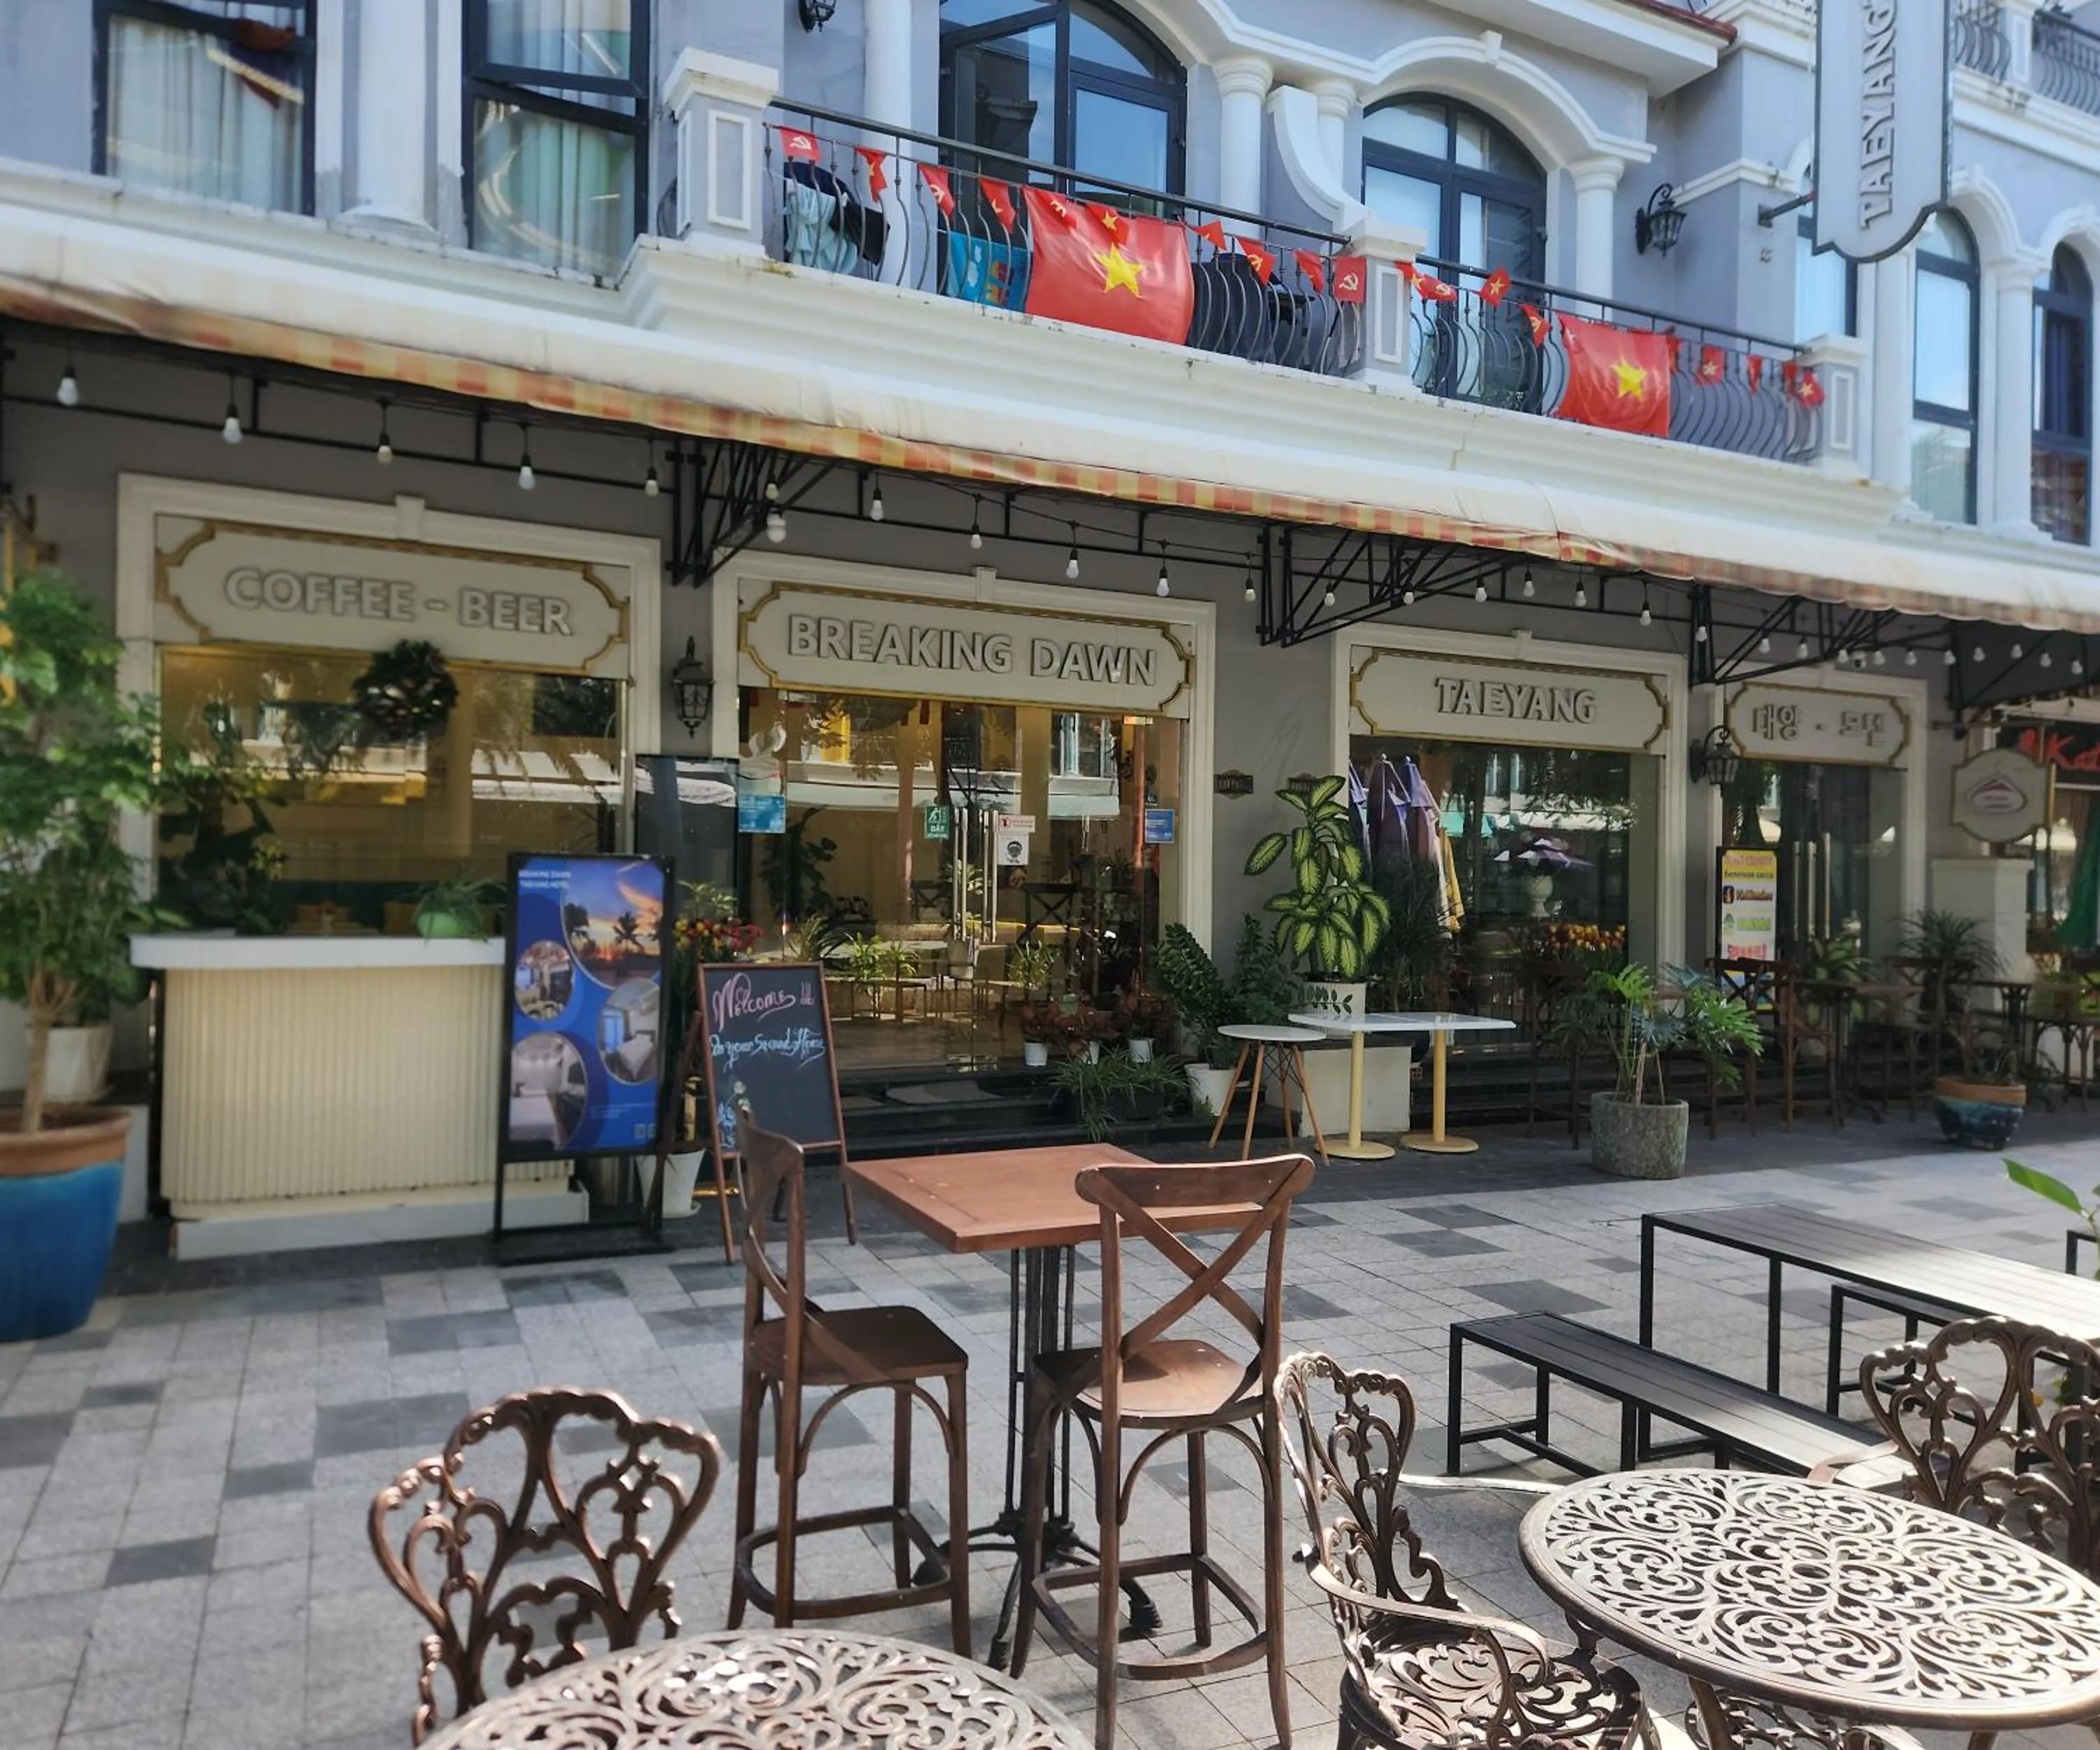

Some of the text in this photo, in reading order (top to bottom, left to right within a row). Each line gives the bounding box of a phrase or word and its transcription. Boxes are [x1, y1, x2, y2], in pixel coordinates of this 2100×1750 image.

[1859, 0, 1898, 230] TAEYANG
[225, 566, 415, 622] COFFEE
[458, 588, 573, 636] BEER
[788, 614, 1156, 686] BREAKING DAWN
[1434, 678, 1597, 724] TAEYANG
[713, 972, 796, 1032] Welcome
